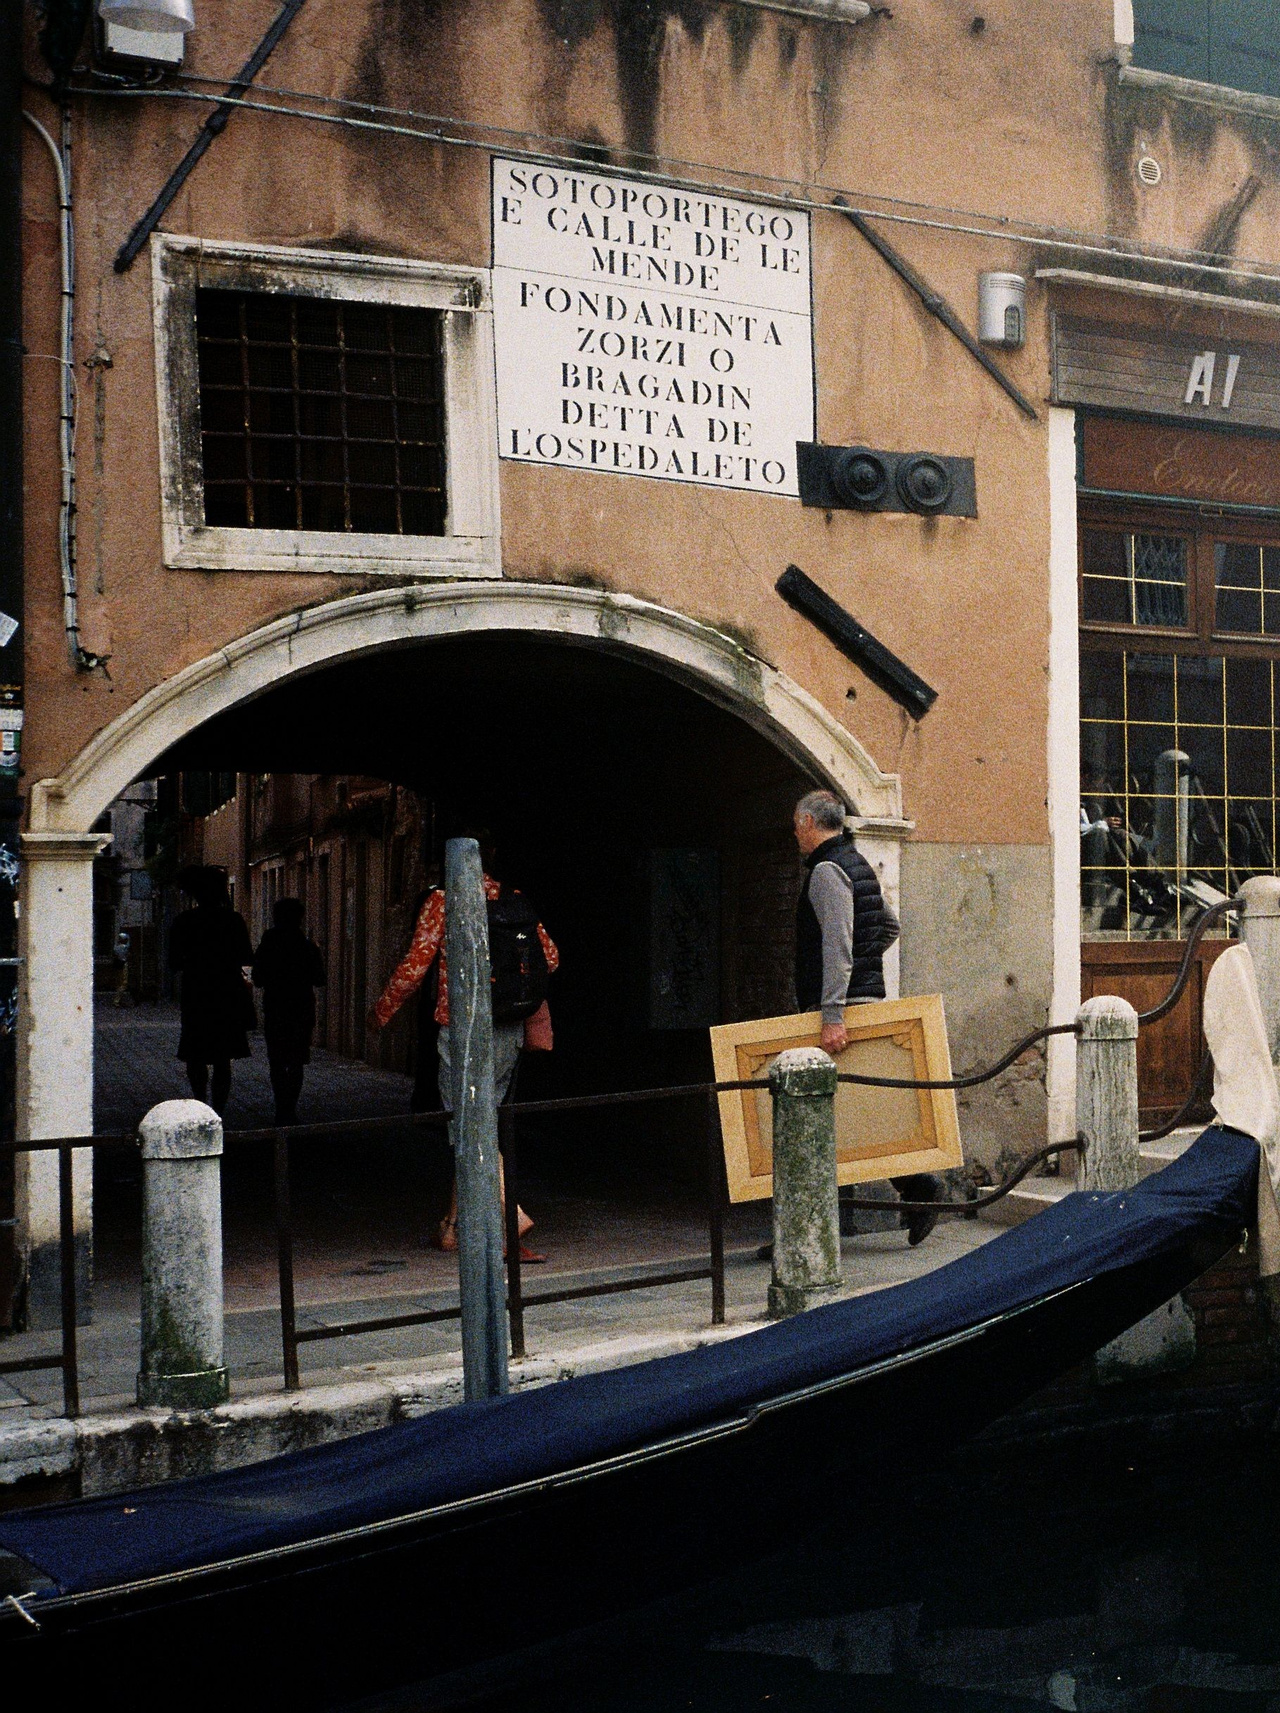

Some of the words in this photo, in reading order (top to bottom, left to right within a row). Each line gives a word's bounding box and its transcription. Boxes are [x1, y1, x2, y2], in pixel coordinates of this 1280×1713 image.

[508, 167, 795, 243] SOTOPORTEGO
[500, 195, 523, 226] E
[546, 205, 673, 253] CALLE
[693, 231, 740, 264] DE
[760, 243, 802, 276] LE
[591, 246, 720, 293] MENDE
[518, 281, 784, 348] FONDAMENTA
[576, 326, 686, 368] ZORZI
[709, 347, 736, 374] O
[560, 362, 753, 412] BRAGADIN
[1185, 351, 1241, 410] AI
[560, 398, 686, 441] DETTA
[706, 417, 753, 448] DE
[510, 428, 787, 486] L'OSPEDALETO
